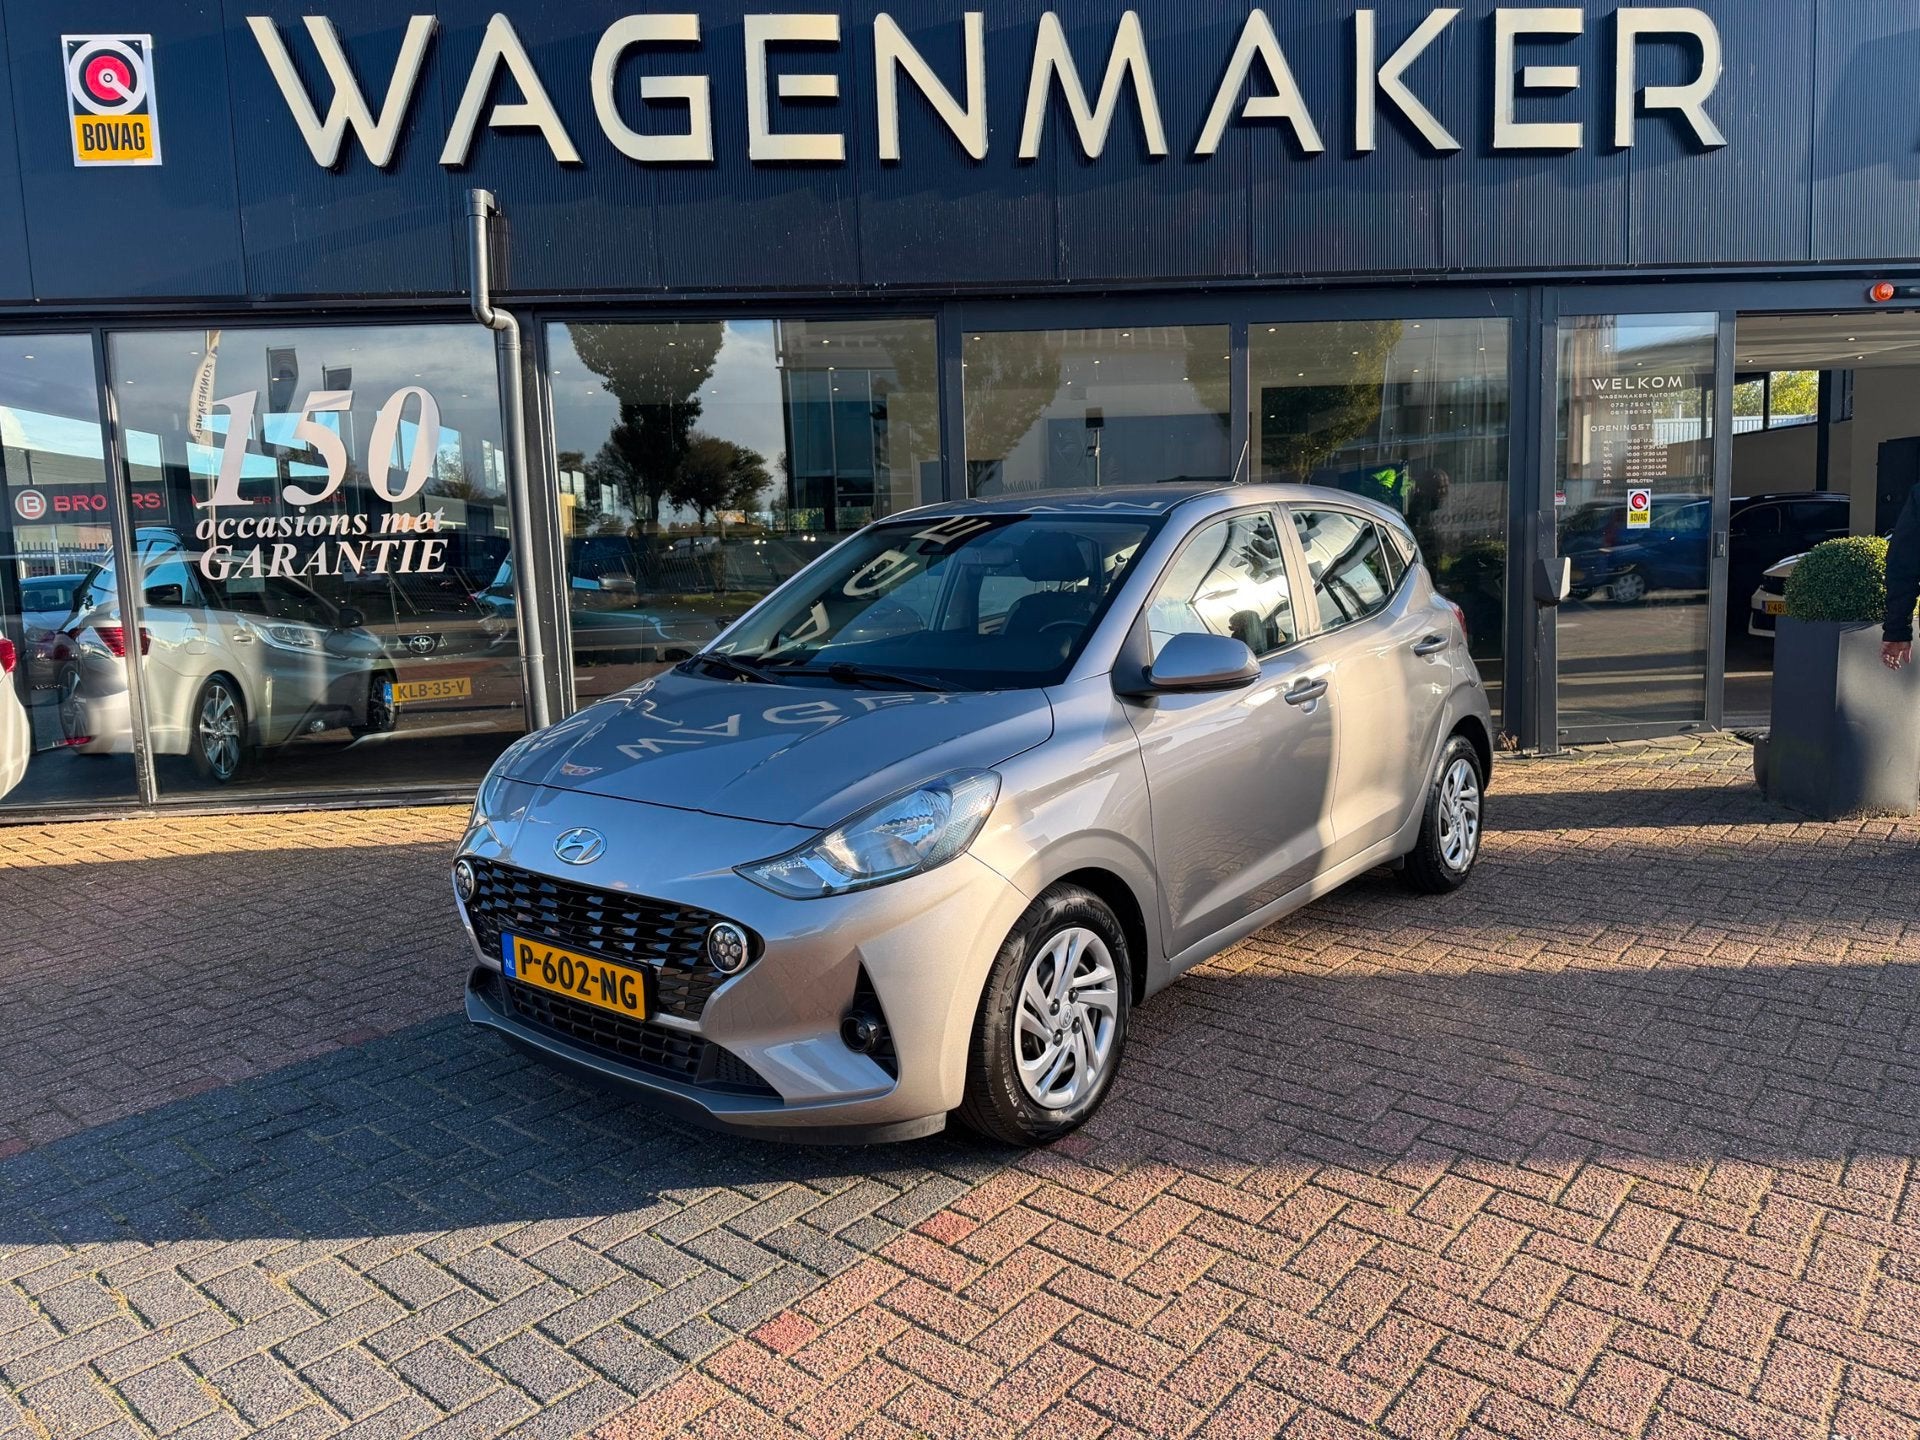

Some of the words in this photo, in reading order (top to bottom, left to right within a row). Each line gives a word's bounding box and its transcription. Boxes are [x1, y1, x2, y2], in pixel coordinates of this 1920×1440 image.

[246, 7, 1728, 169] WAGENMAKER
[82, 122, 146, 152] BOVAG
[1591, 376, 1683, 391] WELKOM
[194, 385, 441, 507] 150
[195, 507, 368, 540] occasions
[380, 507, 445, 534] met
[1630, 513, 1648, 522] BOVAG
[199, 538, 448, 582] GARANTIE
[398, 680, 465, 699] KLB-35-V
[505, 957, 515, 970] NL
[519, 943, 638, 1010] P-602-NG
